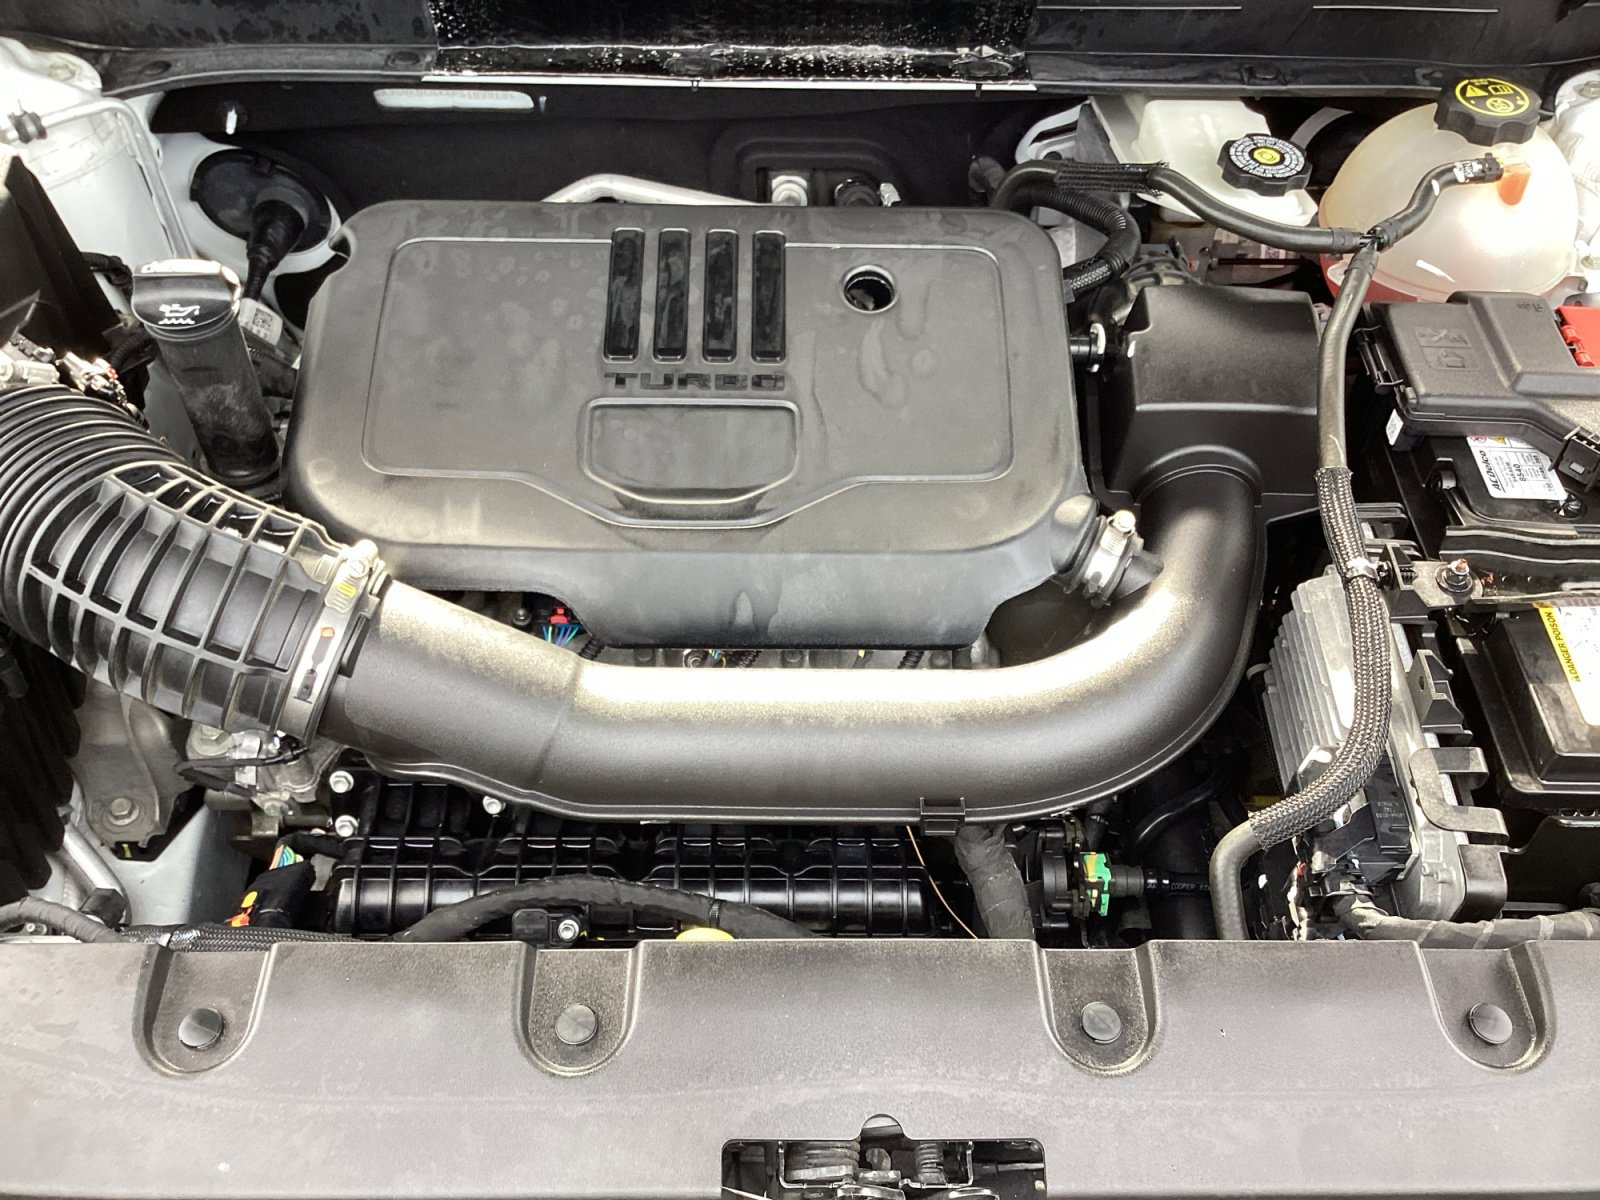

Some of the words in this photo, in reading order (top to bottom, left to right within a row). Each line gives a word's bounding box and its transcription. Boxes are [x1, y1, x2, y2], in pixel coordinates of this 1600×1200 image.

[603, 372, 786, 392] TURBO
[1479, 449, 1502, 491] ACDelco
[1513, 463, 1527, 482] 8540
[1544, 611, 1564, 641] POISON
[1558, 642, 1578, 675] DANGER
